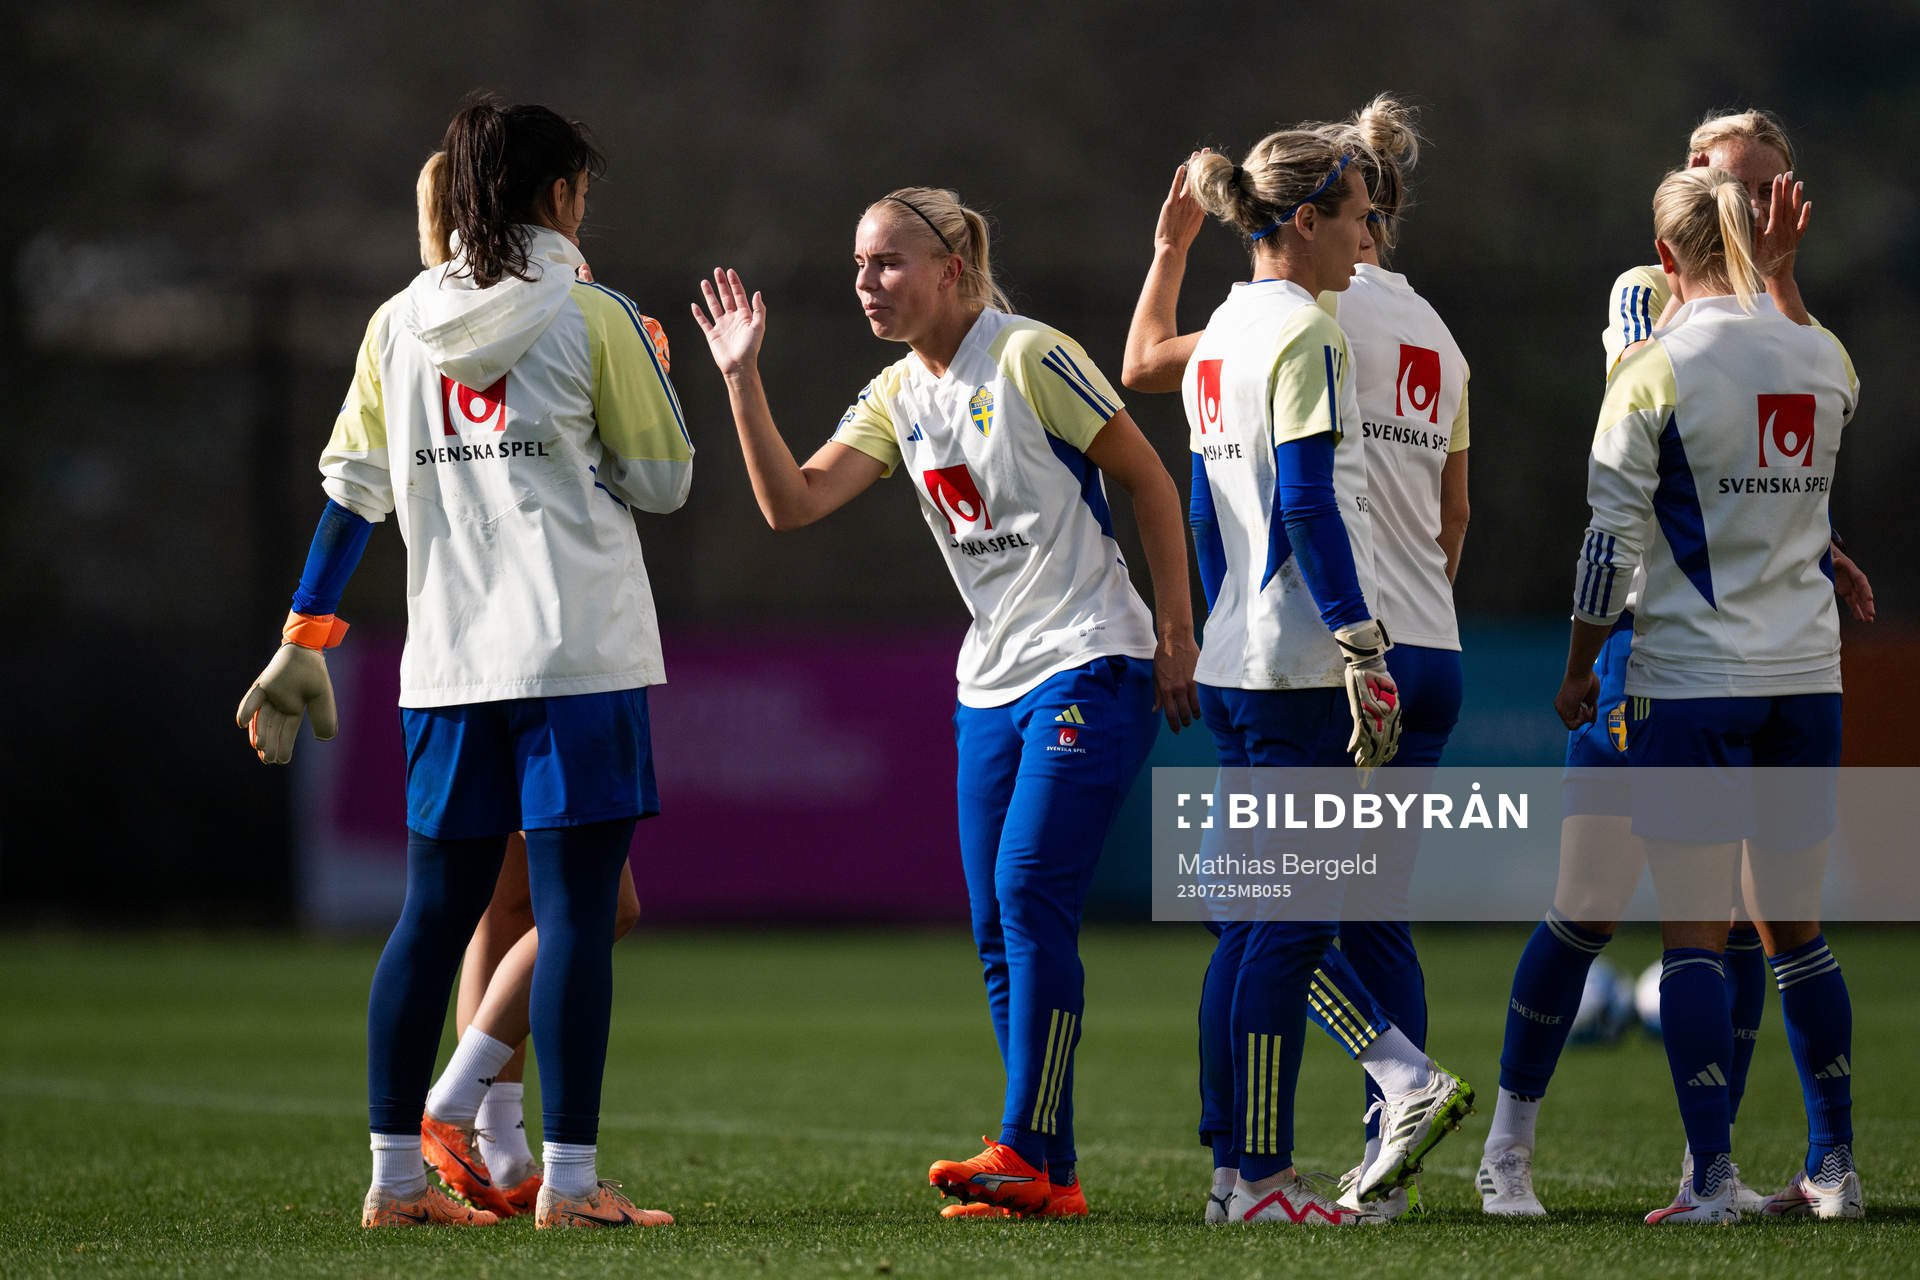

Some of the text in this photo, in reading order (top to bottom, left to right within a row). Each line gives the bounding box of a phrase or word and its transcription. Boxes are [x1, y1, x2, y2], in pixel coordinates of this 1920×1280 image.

[1361, 422, 1429, 448] SVENSKA
[415, 441, 549, 465] SVENSKA SPEL
[1718, 478, 1801, 494] SVENSKA
[988, 533, 1029, 552] SPEL
[1511, 997, 1564, 1025] SVERIGE
